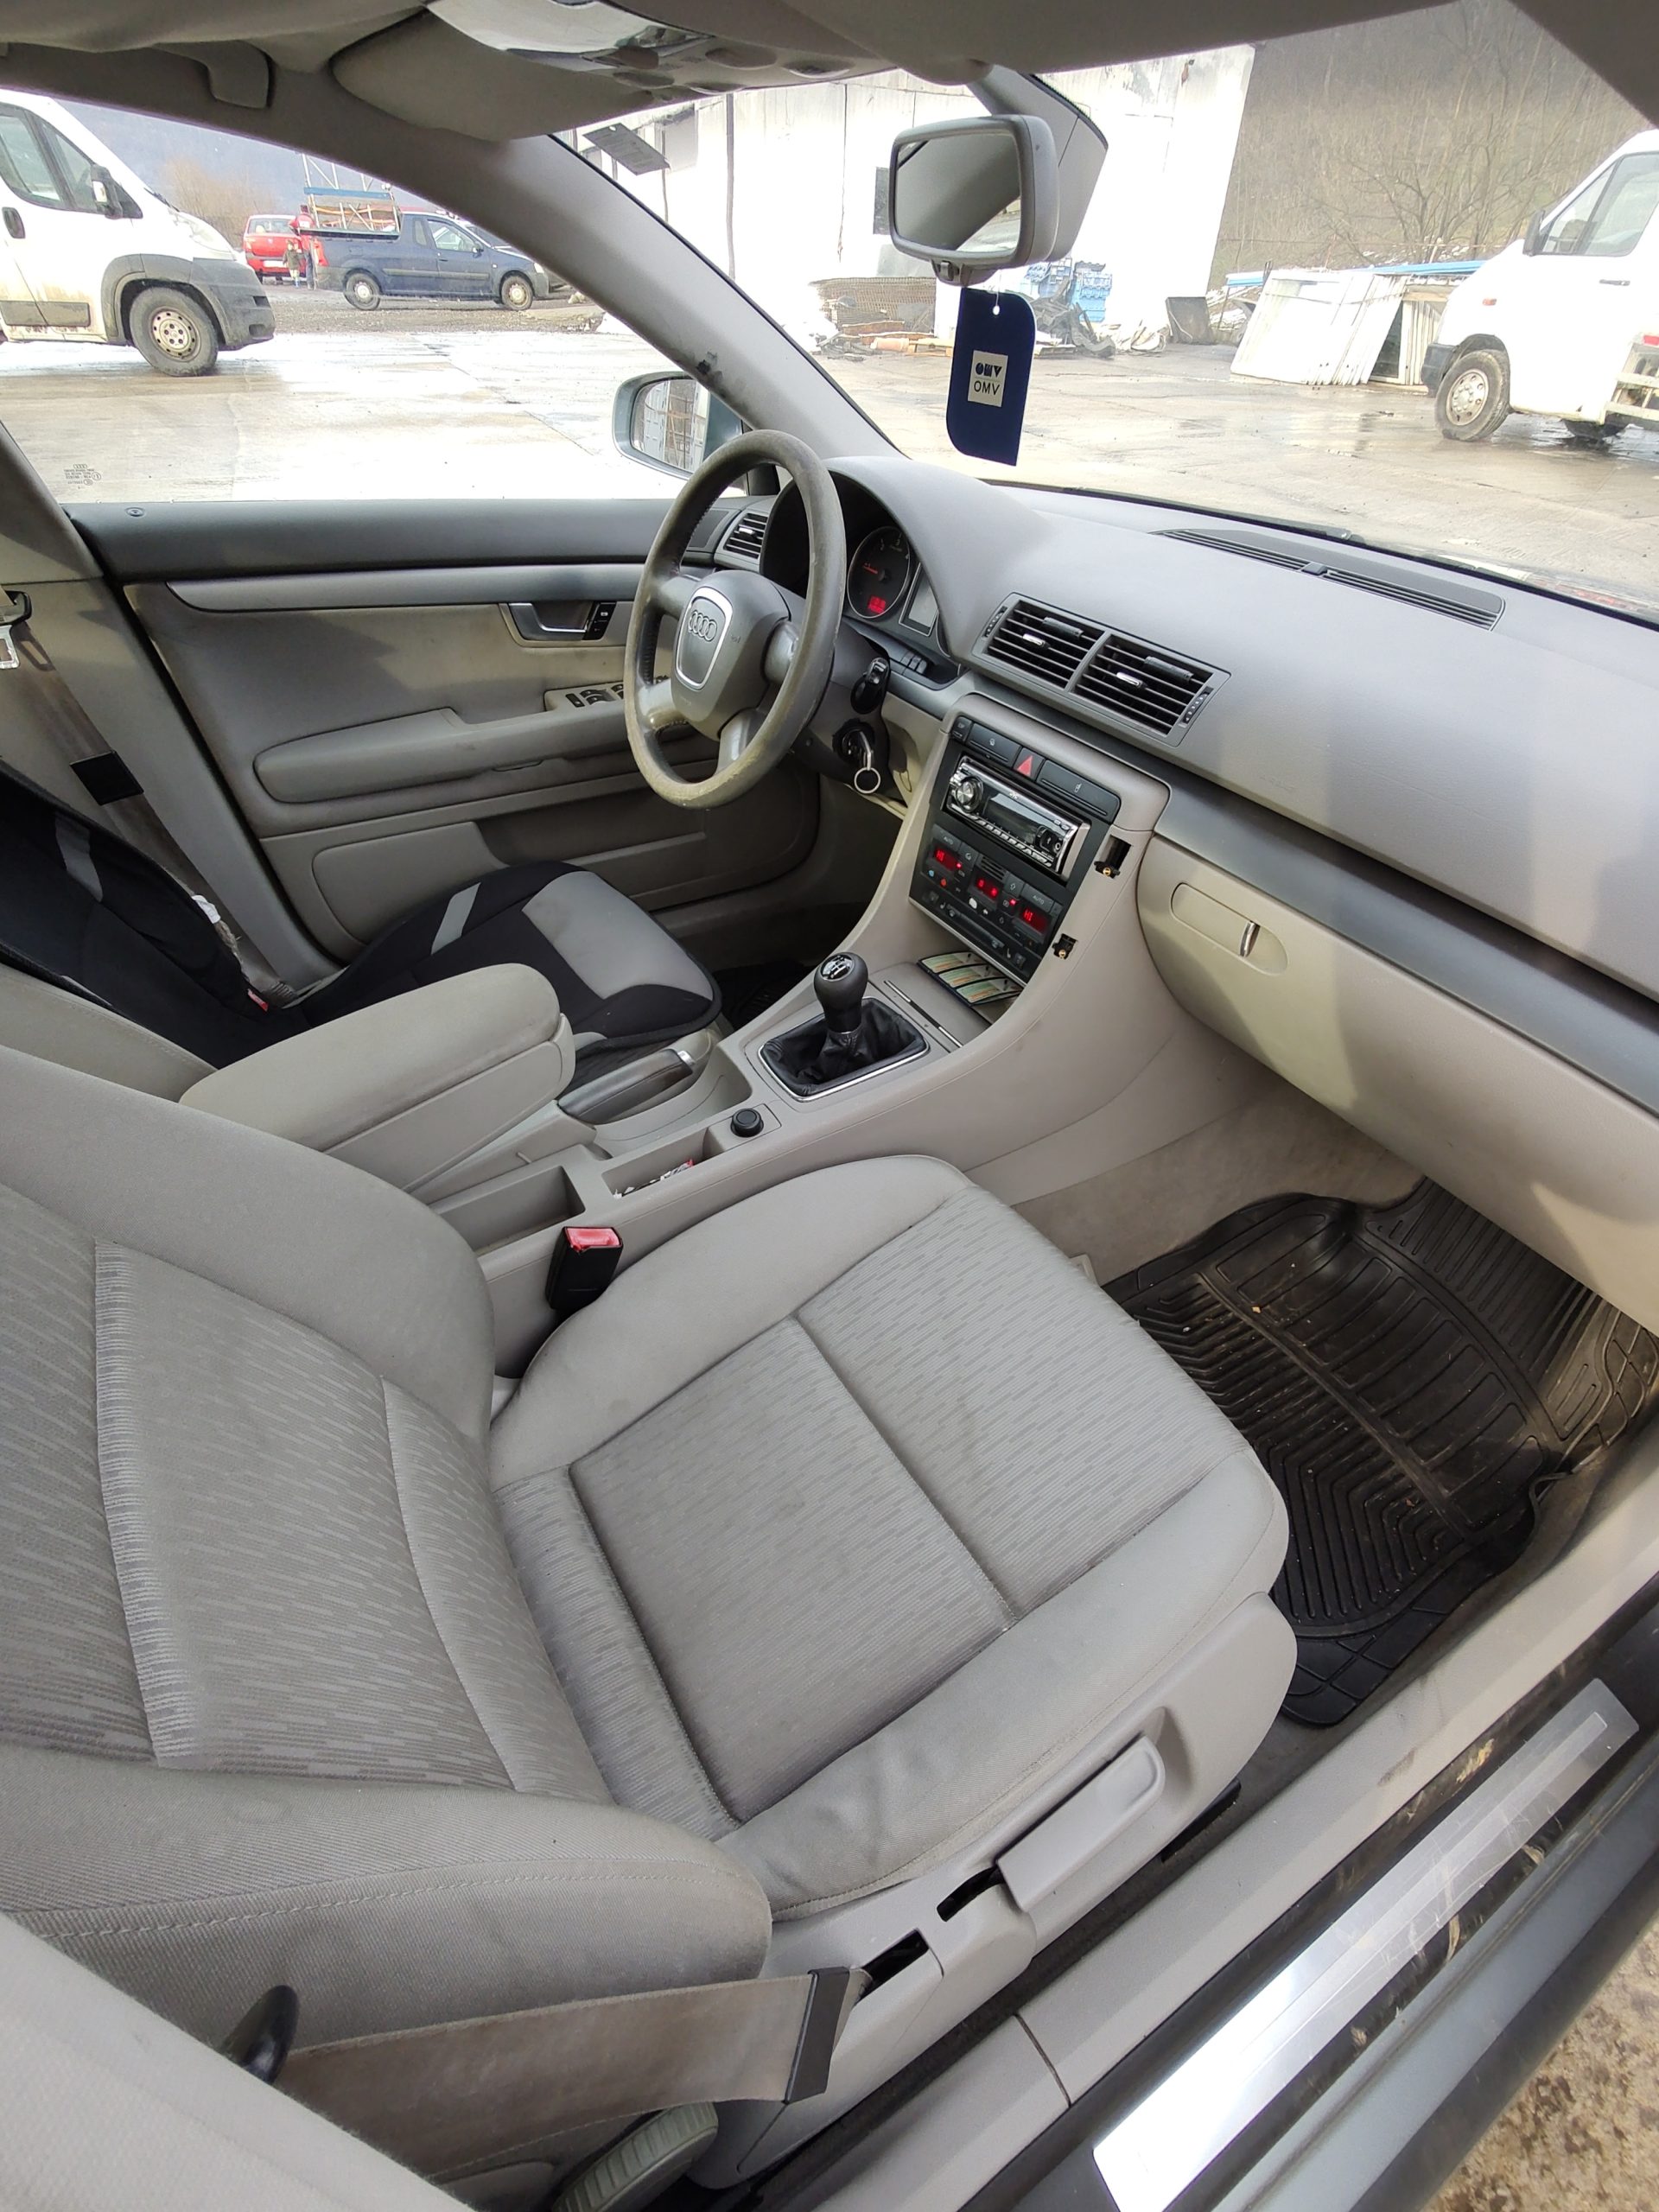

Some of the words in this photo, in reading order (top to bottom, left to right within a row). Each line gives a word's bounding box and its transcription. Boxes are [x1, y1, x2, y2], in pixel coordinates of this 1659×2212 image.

[976, 362, 1002, 378] OMV
[974, 380, 1001, 396] OMV
[1033, 894, 1045, 905] AUTO
[1023, 908, 1033, 922] HI
